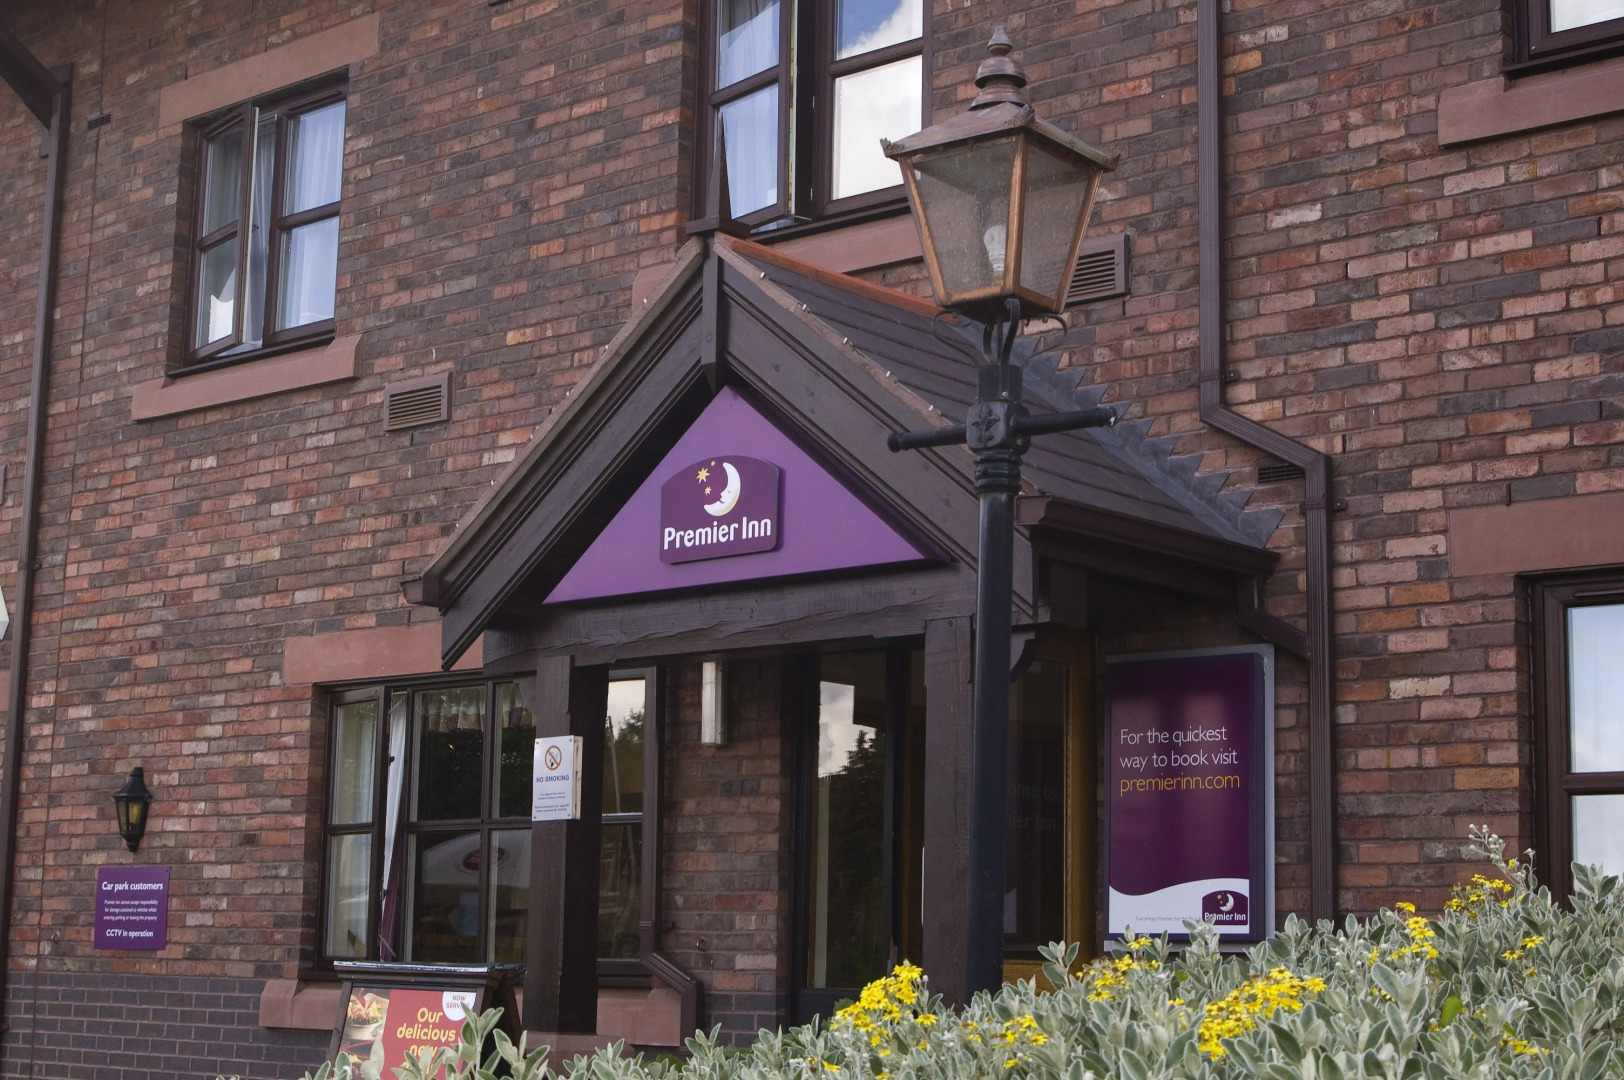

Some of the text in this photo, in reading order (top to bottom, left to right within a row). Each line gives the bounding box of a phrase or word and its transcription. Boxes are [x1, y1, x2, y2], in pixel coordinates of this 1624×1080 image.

[664, 517, 771, 550] Premier Inn
[1121, 725, 1227, 747] For the quickest
[1120, 747, 1238, 772] way to book visit
[1121, 771, 1239, 797] premierinn.com
[102, 881, 163, 892] Car park customers
[1204, 912, 1246, 921] Pmier Inn
[106, 929, 122, 937] CCTV
[129, 930, 153, 939] operation
[417, 1007, 443, 1023] Our
[397, 1023, 456, 1042] delicious
